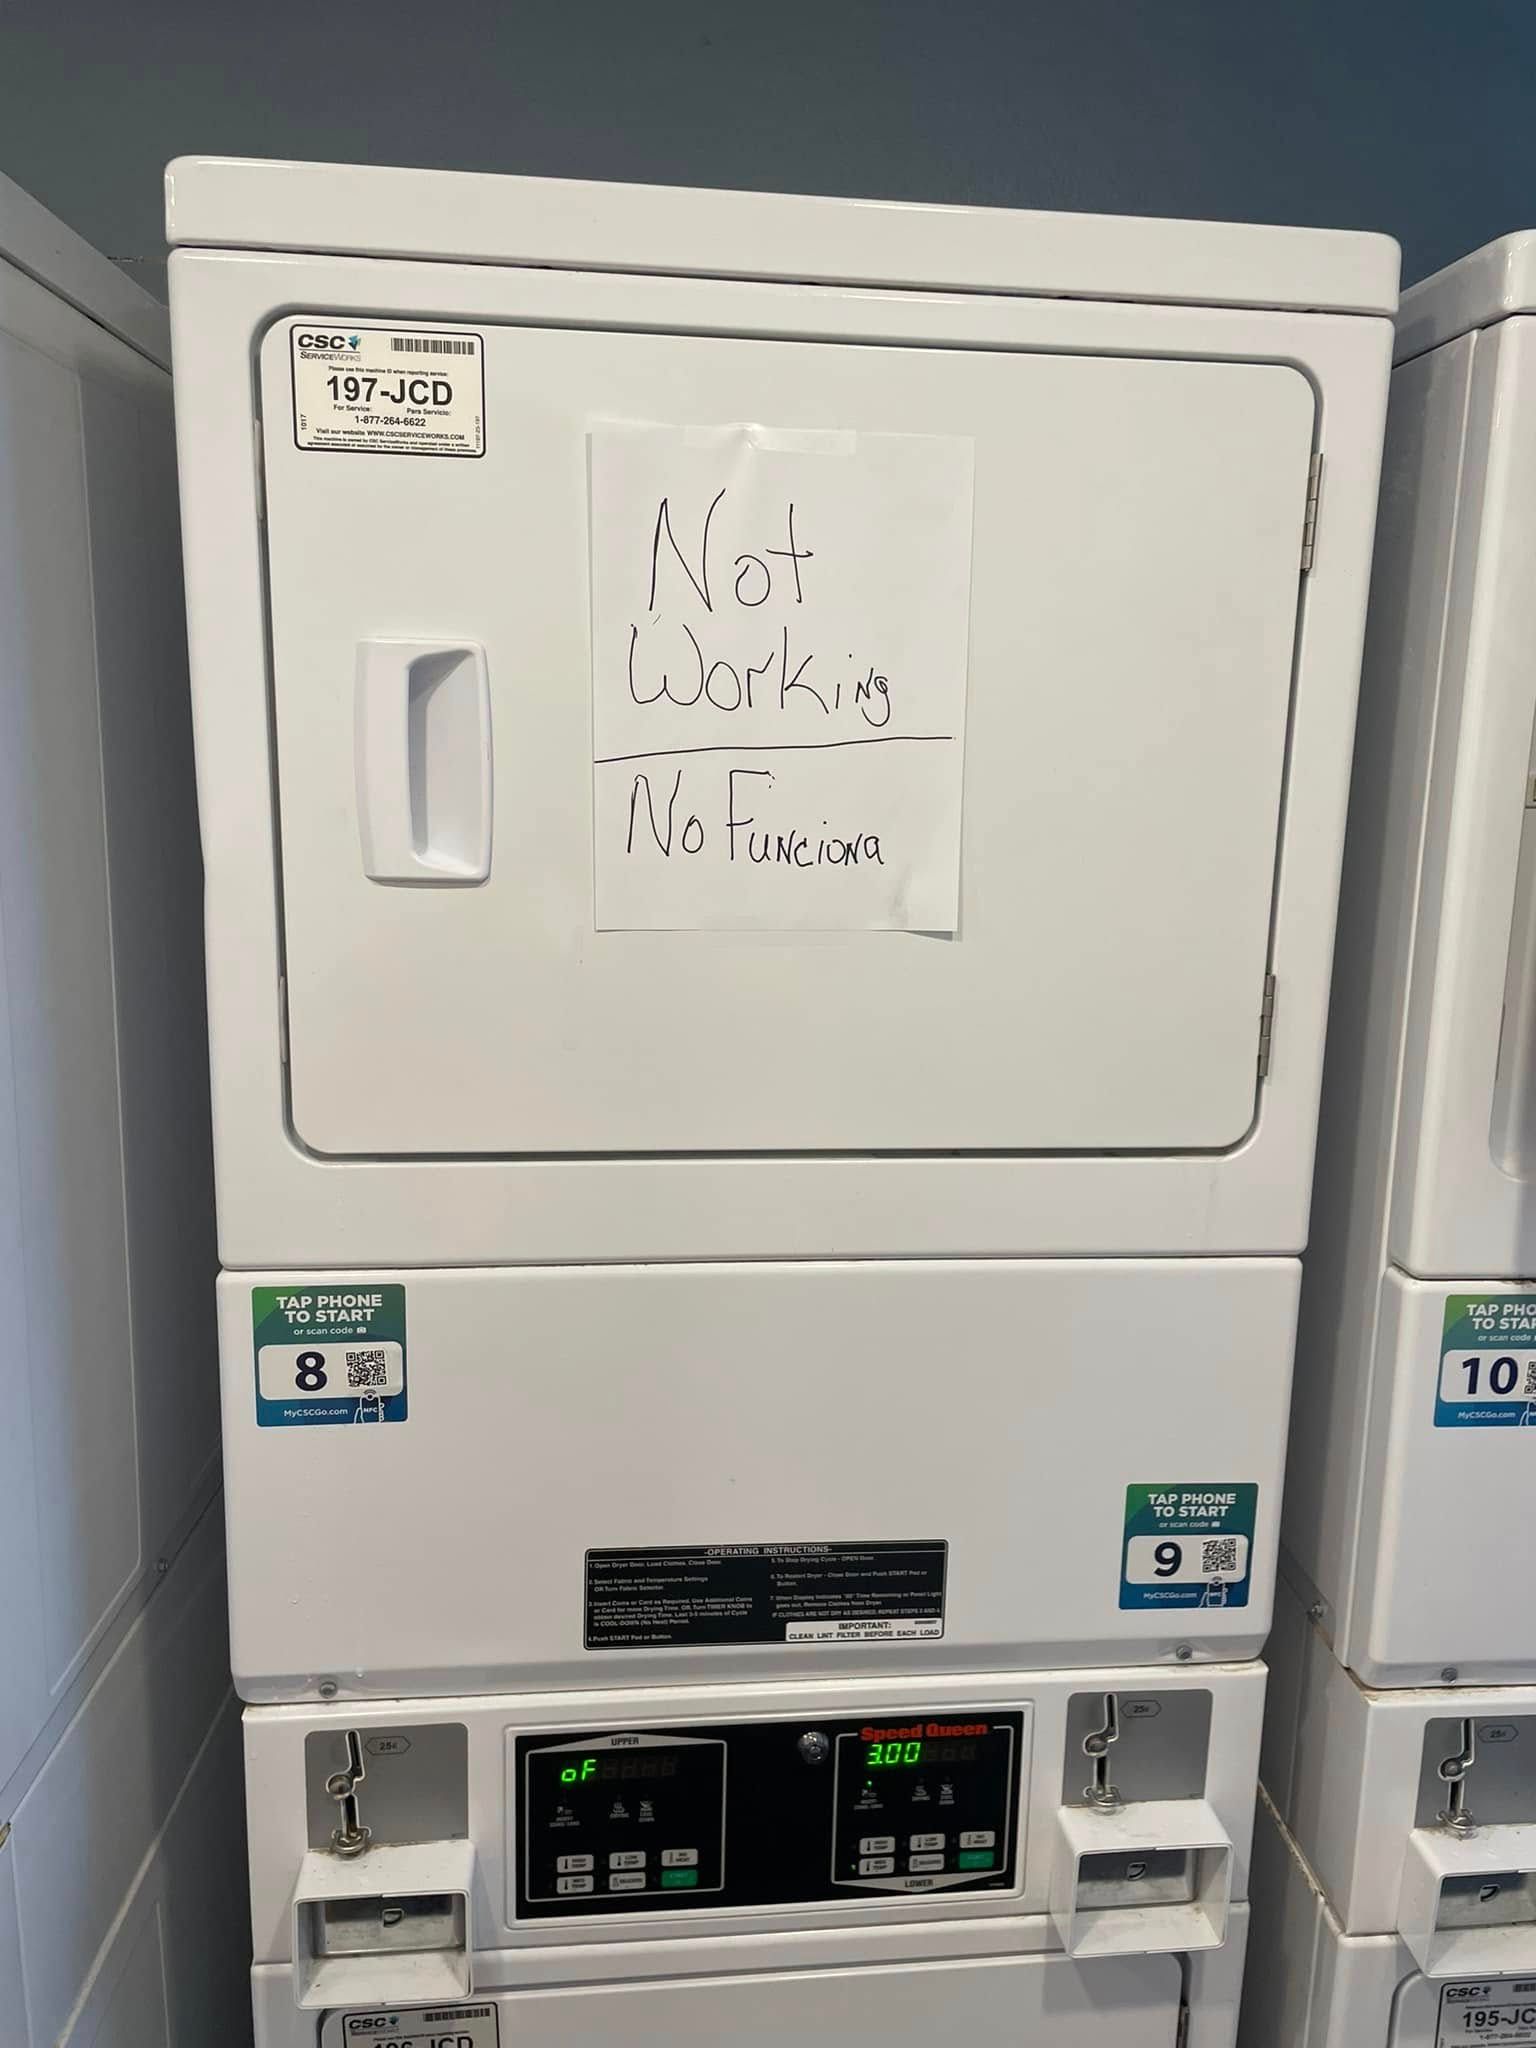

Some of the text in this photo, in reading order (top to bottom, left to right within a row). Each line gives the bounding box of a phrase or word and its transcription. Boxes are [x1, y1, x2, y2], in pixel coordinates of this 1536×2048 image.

[298, 334, 345, 349] CSC
[327, 375, 453, 406] 197-JCD
[406, 407, 421, 415] Para
[355, 415, 426, 427] 1-877-264-6622
[649, 488, 813, 612] Not
[629, 623, 891, 727] Working
[628, 769, 885, 867] No Funciona
[276, 1294, 382, 1309] TAP PHONE
[285, 1308, 375, 1323] TO START
[1466, 1304, 1499, 1316] TAP
[1471, 1318, 1495, 1329] TO
[306, 1327, 328, 1335] scan
[330, 1326, 353, 1335] code
[1510, 1334, 1531, 1342] code
[295, 1351, 328, 1392] 8
[1462, 1357, 1518, 1395] 10
[284, 1408, 348, 1418] MyCSCGo.com
[1457, 1411, 1516, 1420] MyCSCGo.com
[1148, 1493, 1236, 1505] TAP PHONE
[1153, 1506, 1229, 1517] TO START
[1153, 1541, 1182, 1577] 9
[838, 1622, 891, 1630] IMPORTANT:
[789, 1632, 814, 1640] CLEAN
[864, 1630, 893, 1638] BEFORE
[897, 1629, 917, 1637] EACH
[861, 1723, 988, 1743] Speed Queen
[611, 1737, 639, 1746] UPPER
[904, 1879, 934, 1888] LOWER
[1447, 1987, 1480, 1998] CSC
[349, 2017, 387, 2029] CSC
